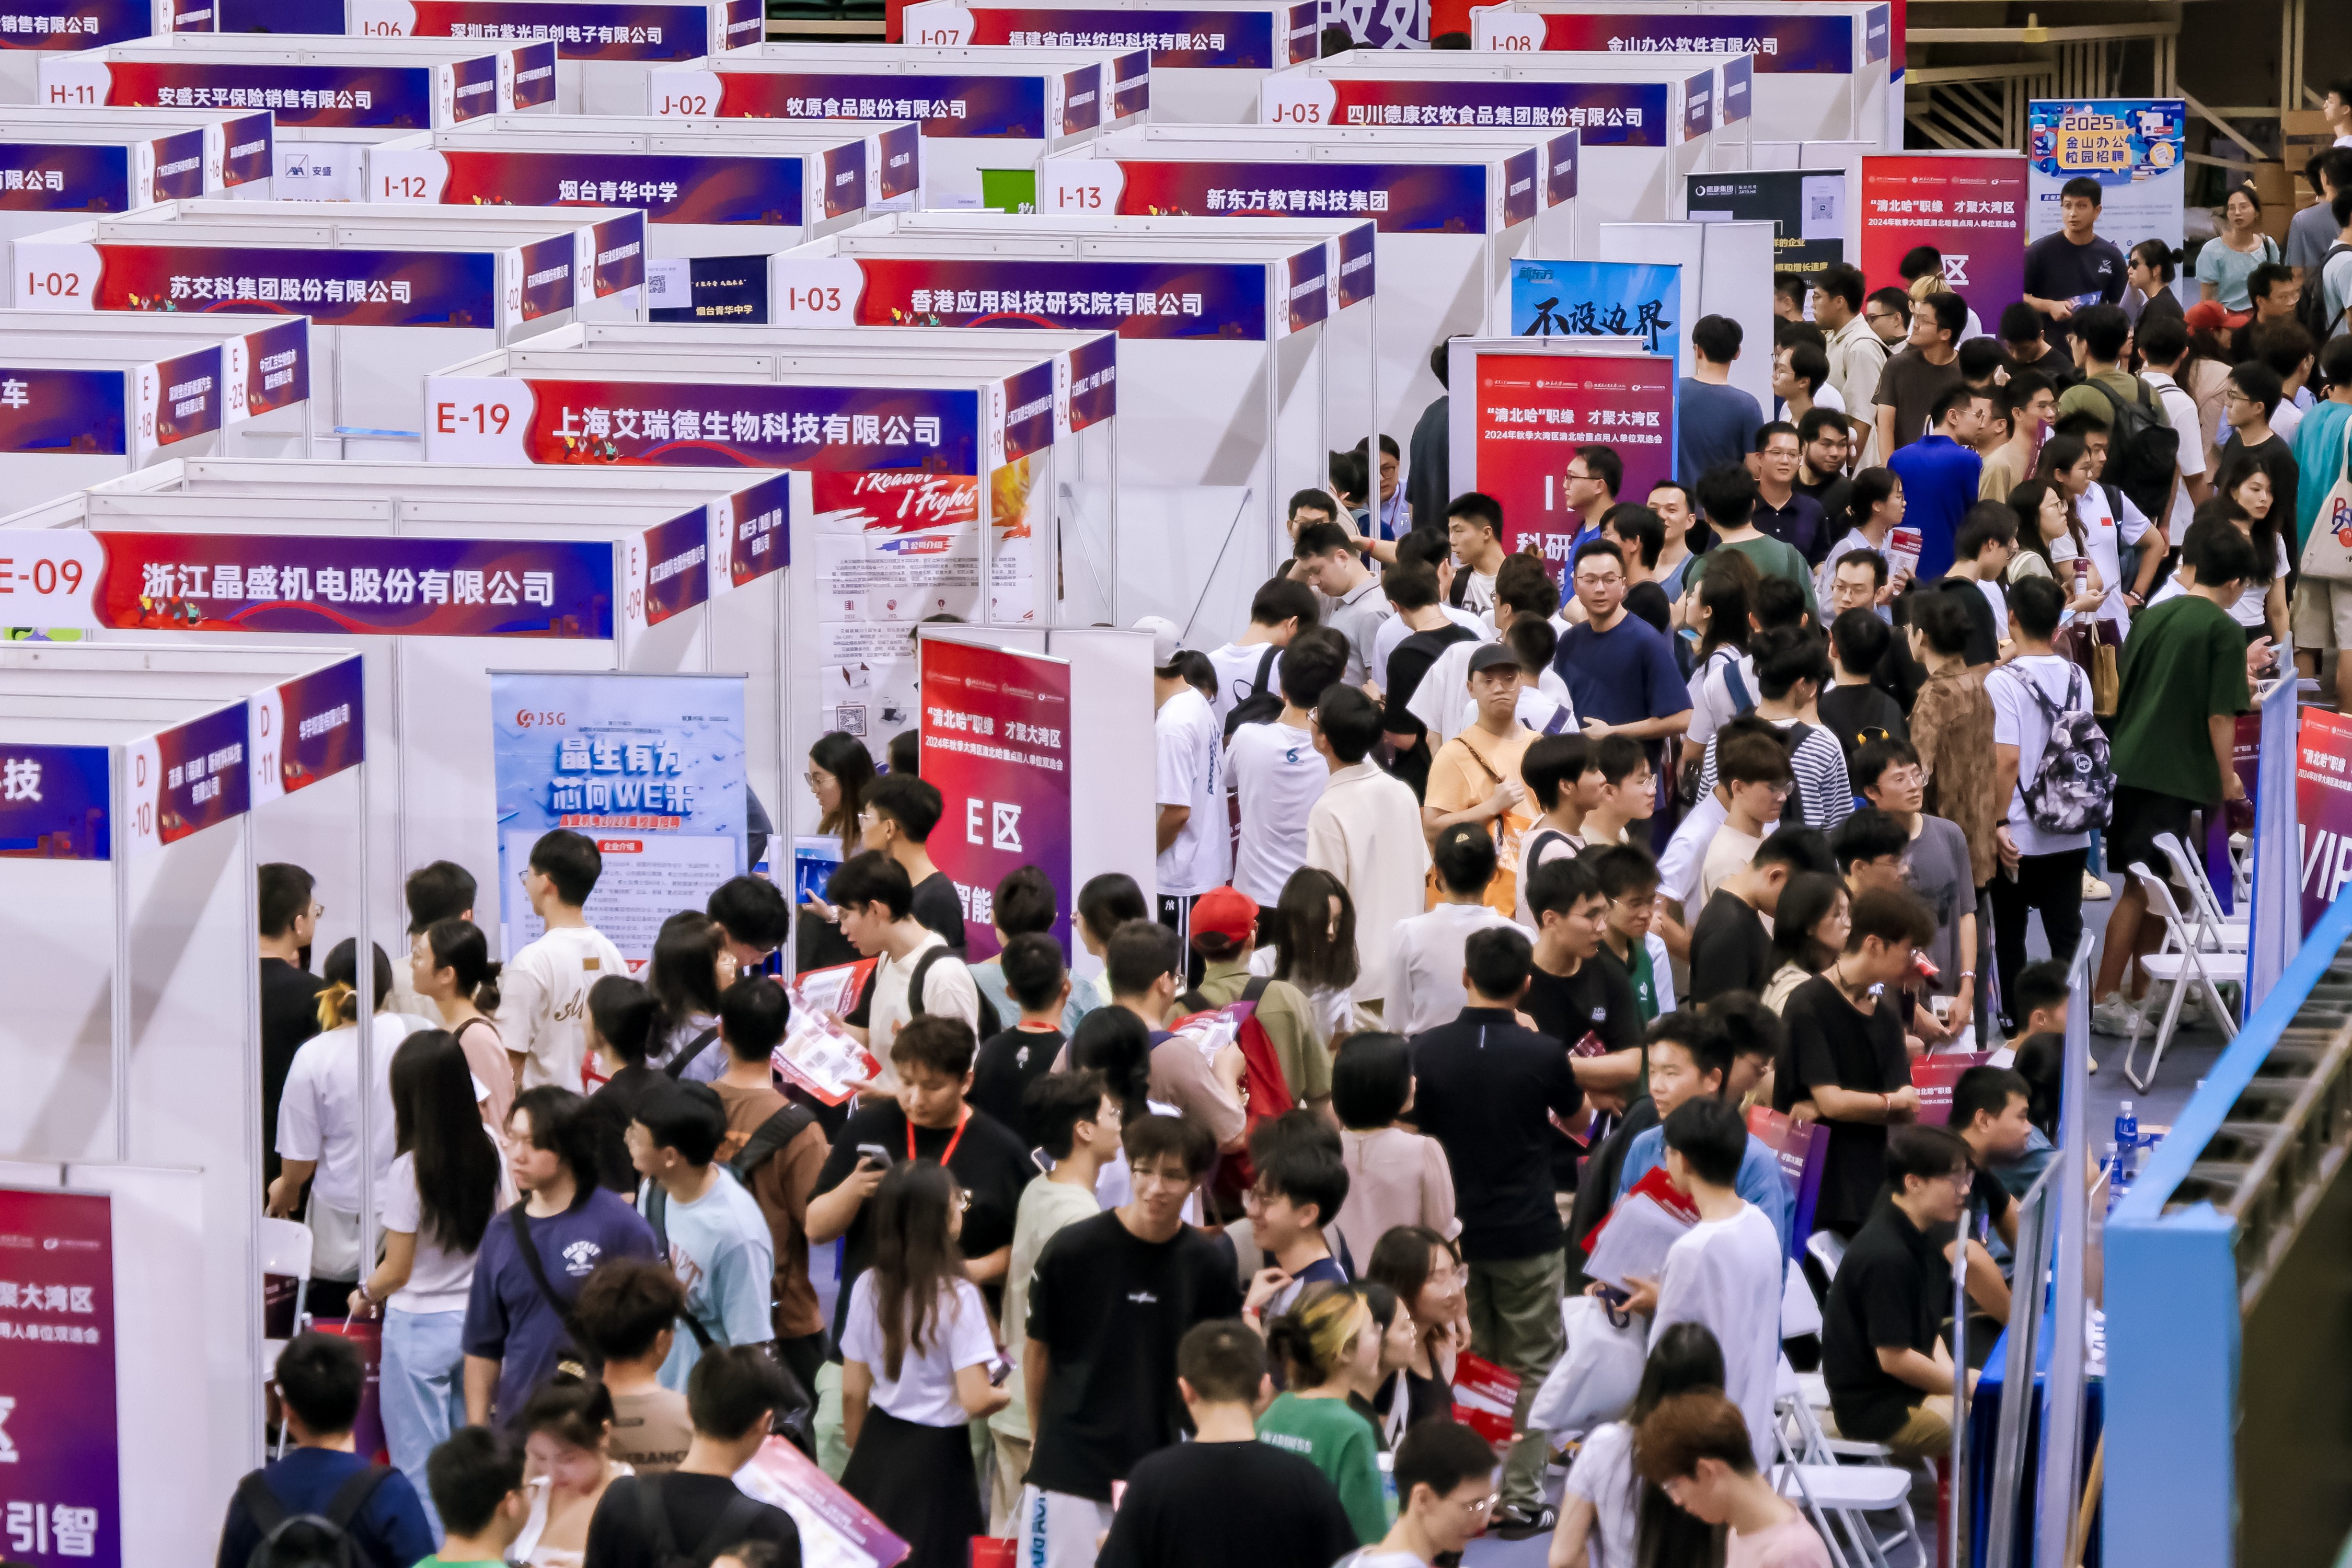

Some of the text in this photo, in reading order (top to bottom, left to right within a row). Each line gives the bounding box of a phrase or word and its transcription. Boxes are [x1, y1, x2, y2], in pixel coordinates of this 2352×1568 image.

[364, 21, 402, 36] J-06
[451, 23, 662, 44] 深圳市紫光同创电子有限公司
[920, 29, 959, 44] J-07
[1009, 31, 1225, 51] 福建省向兴纺织科技有限公司
[1492, 35, 1531, 50] J-08
[1607, 36, 1778, 56] 金山办公软件有限公司
[50, 85, 95, 103] H-11
[158, 87, 372, 109] 安盛天平保险销售有限公司
[660, 95, 707, 116] J-02
[787, 97, 967, 119] 牧原食品股份有限公司
[1272, 103, 1321, 124] J-03
[1347, 105, 1643, 128] 四川德康农牧食品集团股份有限公司
[2066, 136, 2125, 149] 金山办公
[2066, 151, 2125, 164] 校园招聘
[0, 170, 64, 191] 限公司
[312, 166, 332, 176] 安盛
[385, 176, 426, 198] I-12
[559, 180, 678, 203] 烟台青华中学
[1059, 186, 1102, 209] I-13
[1206, 188, 1389, 211] 新东方教育科技集团
[1954, 200, 2015, 214] 才聚大湾区
[28, 272, 80, 296] I-02
[169, 275, 411, 303] 苏交科集团股份有限公司
[696, 305, 753, 316] 烟台青华中学
[790, 287, 841, 312] I-03
[910, 289, 1202, 316] 香港应用科技研究院有限公司
[1521, 296, 1675, 352] 不设边界
[1, 378, 29, 409] 车
[436, 401, 510, 435] E-19
[552, 407, 941, 447] 上海艾瑞德生物科技有限公司
[1587, 409, 1661, 426] 才聚大湾区
[1484, 430, 1663, 445] 2024年秋季大湾区清北哈重点用人单位双选会
[916, 479, 978, 522] Fight
[142, 563, 554, 605] 浙江晶盛机电股份有限公司
[537, 711, 566, 726] JSG
[1005, 721, 1062, 748] 才聚大湾区
[3, 758, 42, 801] 技
[5, 1500, 99, 1558] 引智
